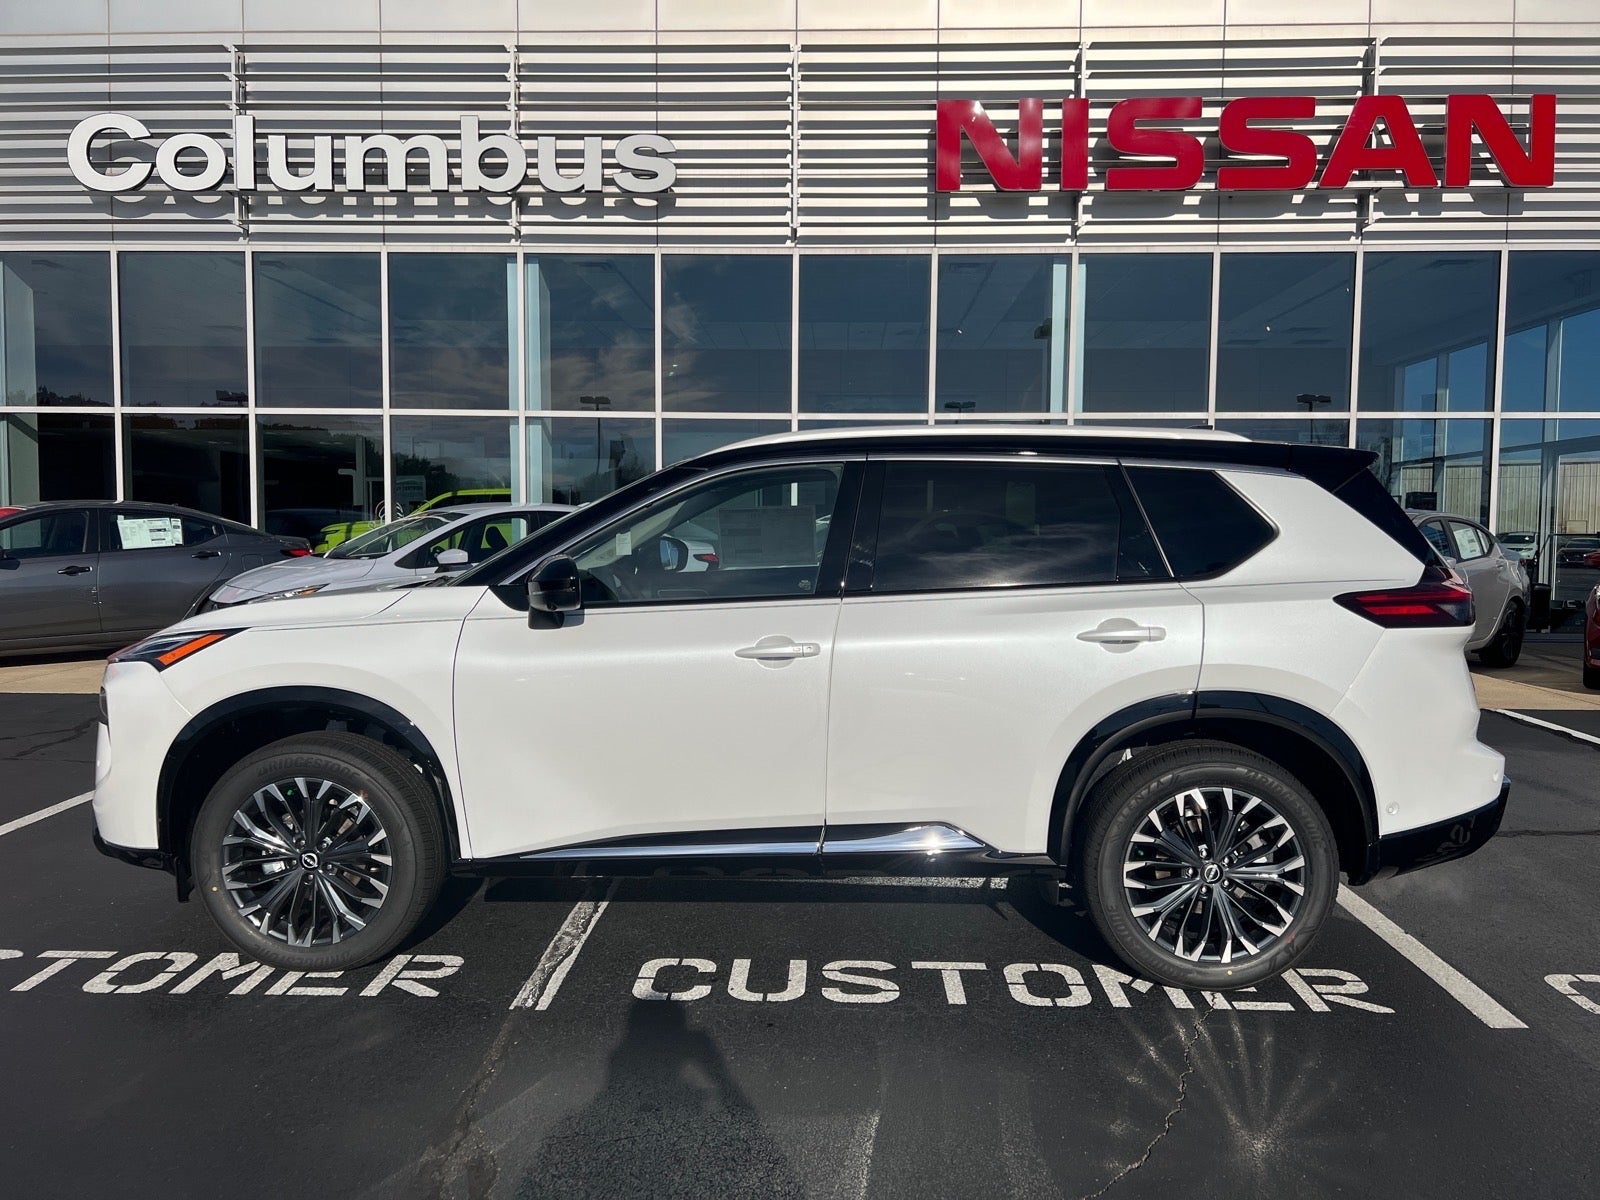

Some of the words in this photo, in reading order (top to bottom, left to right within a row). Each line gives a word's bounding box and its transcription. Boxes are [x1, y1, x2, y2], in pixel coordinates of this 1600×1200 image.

[67, 113, 677, 192] Columbus
[936, 94, 1556, 192] NISSAN
[0, 949, 465, 998] TOMER
[632, 958, 1395, 1014] CUSTOMER
